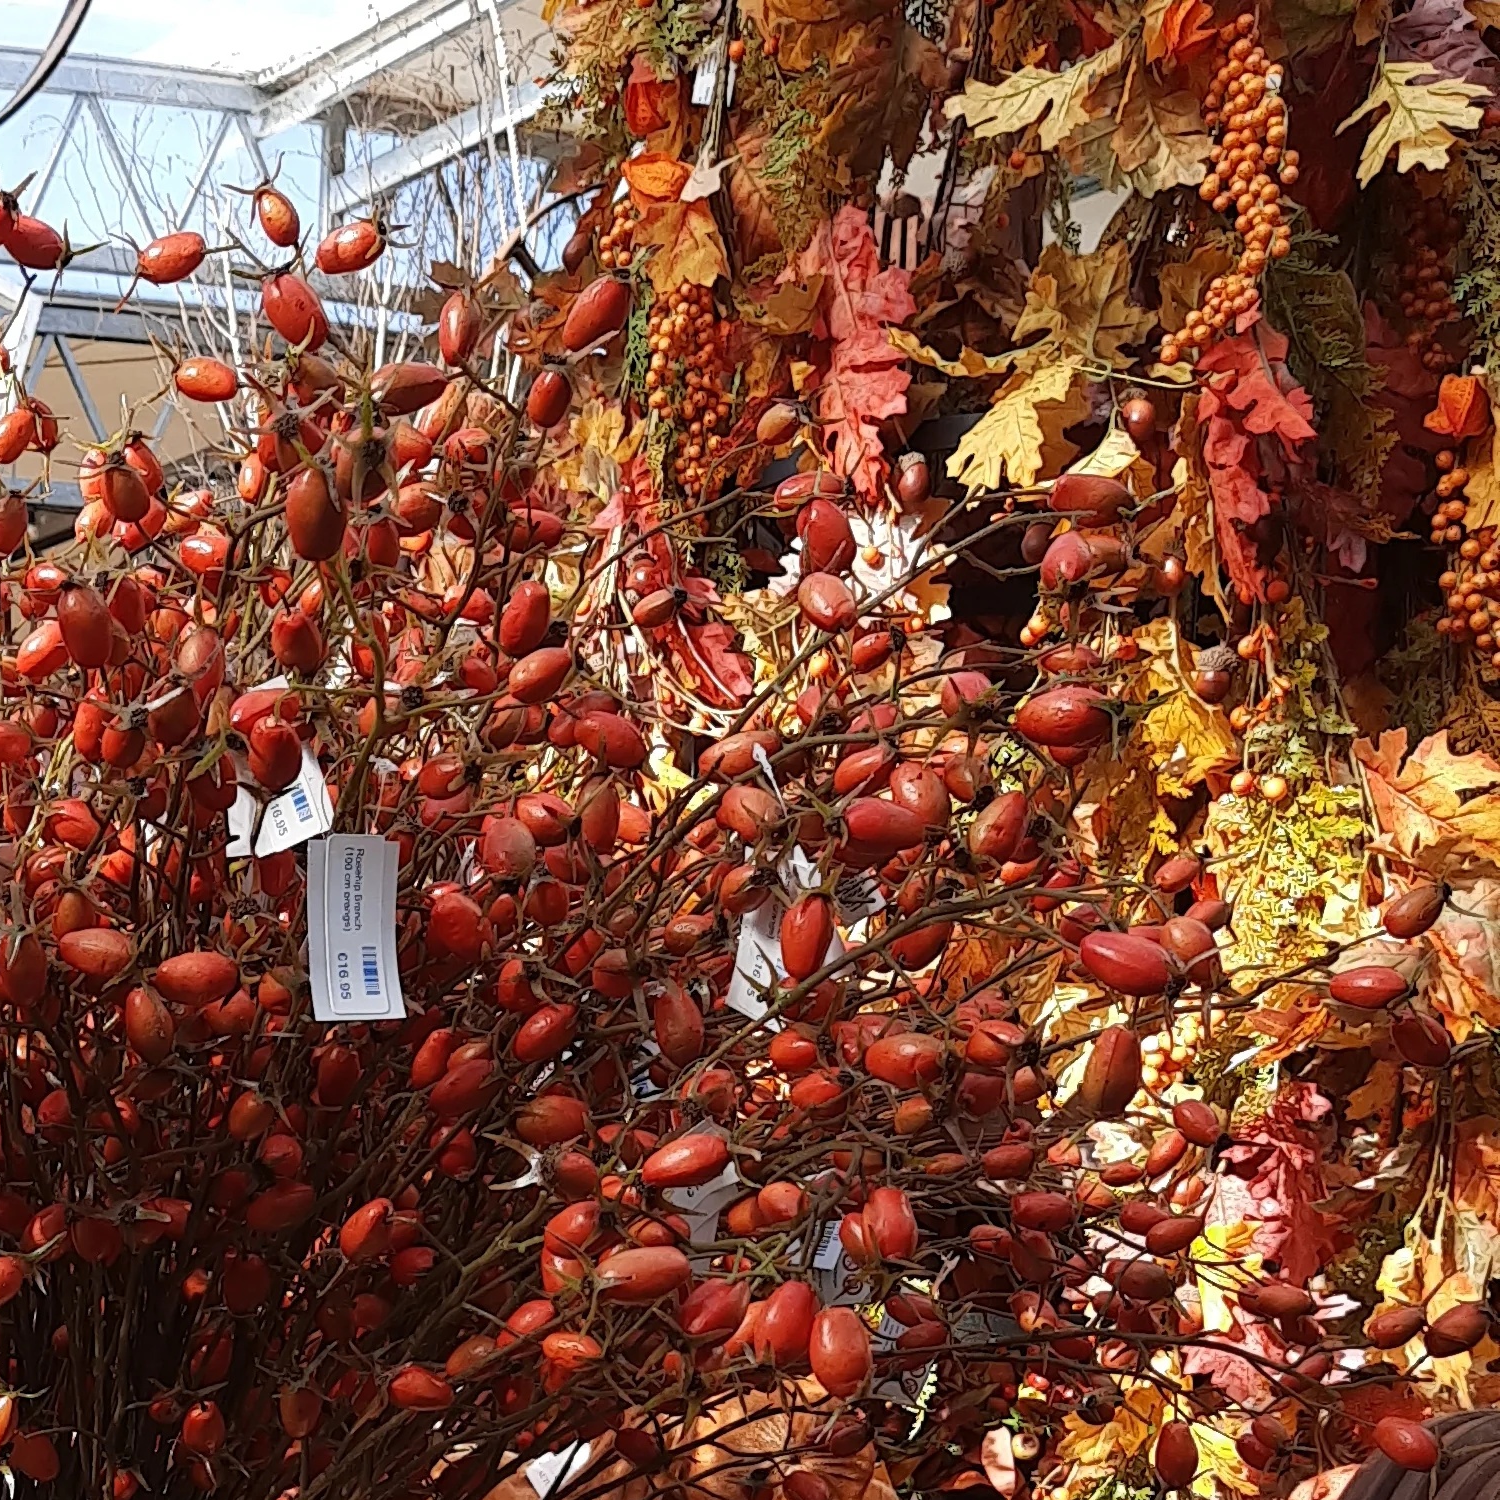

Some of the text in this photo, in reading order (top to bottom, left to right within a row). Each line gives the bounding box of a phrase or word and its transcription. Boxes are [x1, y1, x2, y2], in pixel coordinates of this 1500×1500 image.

[344, 847, 354, 871] (100
[344, 873, 351, 889] cm
[354, 848, 365, 931] Rosehip Branch
